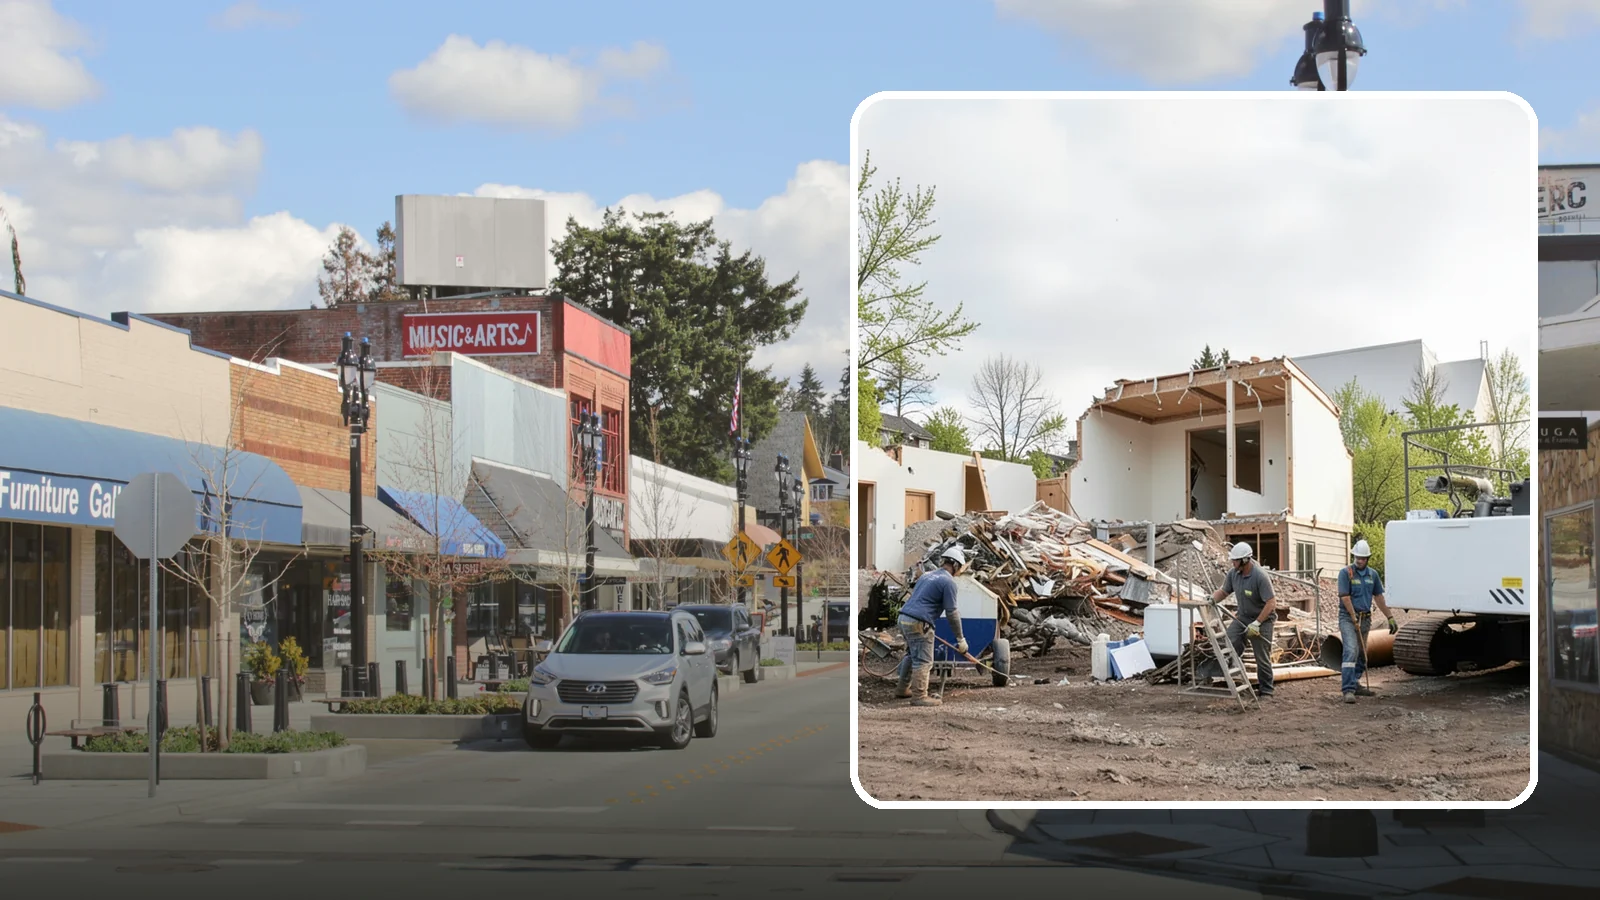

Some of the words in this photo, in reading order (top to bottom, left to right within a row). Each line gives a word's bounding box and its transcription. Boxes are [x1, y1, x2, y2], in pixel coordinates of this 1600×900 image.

[409, 323, 519, 349] MUSIC&ARTS
[1540, 428, 1577, 436] UGA
[0, 472, 79, 514] Furniture
[90, 482, 121, 519] Gal
